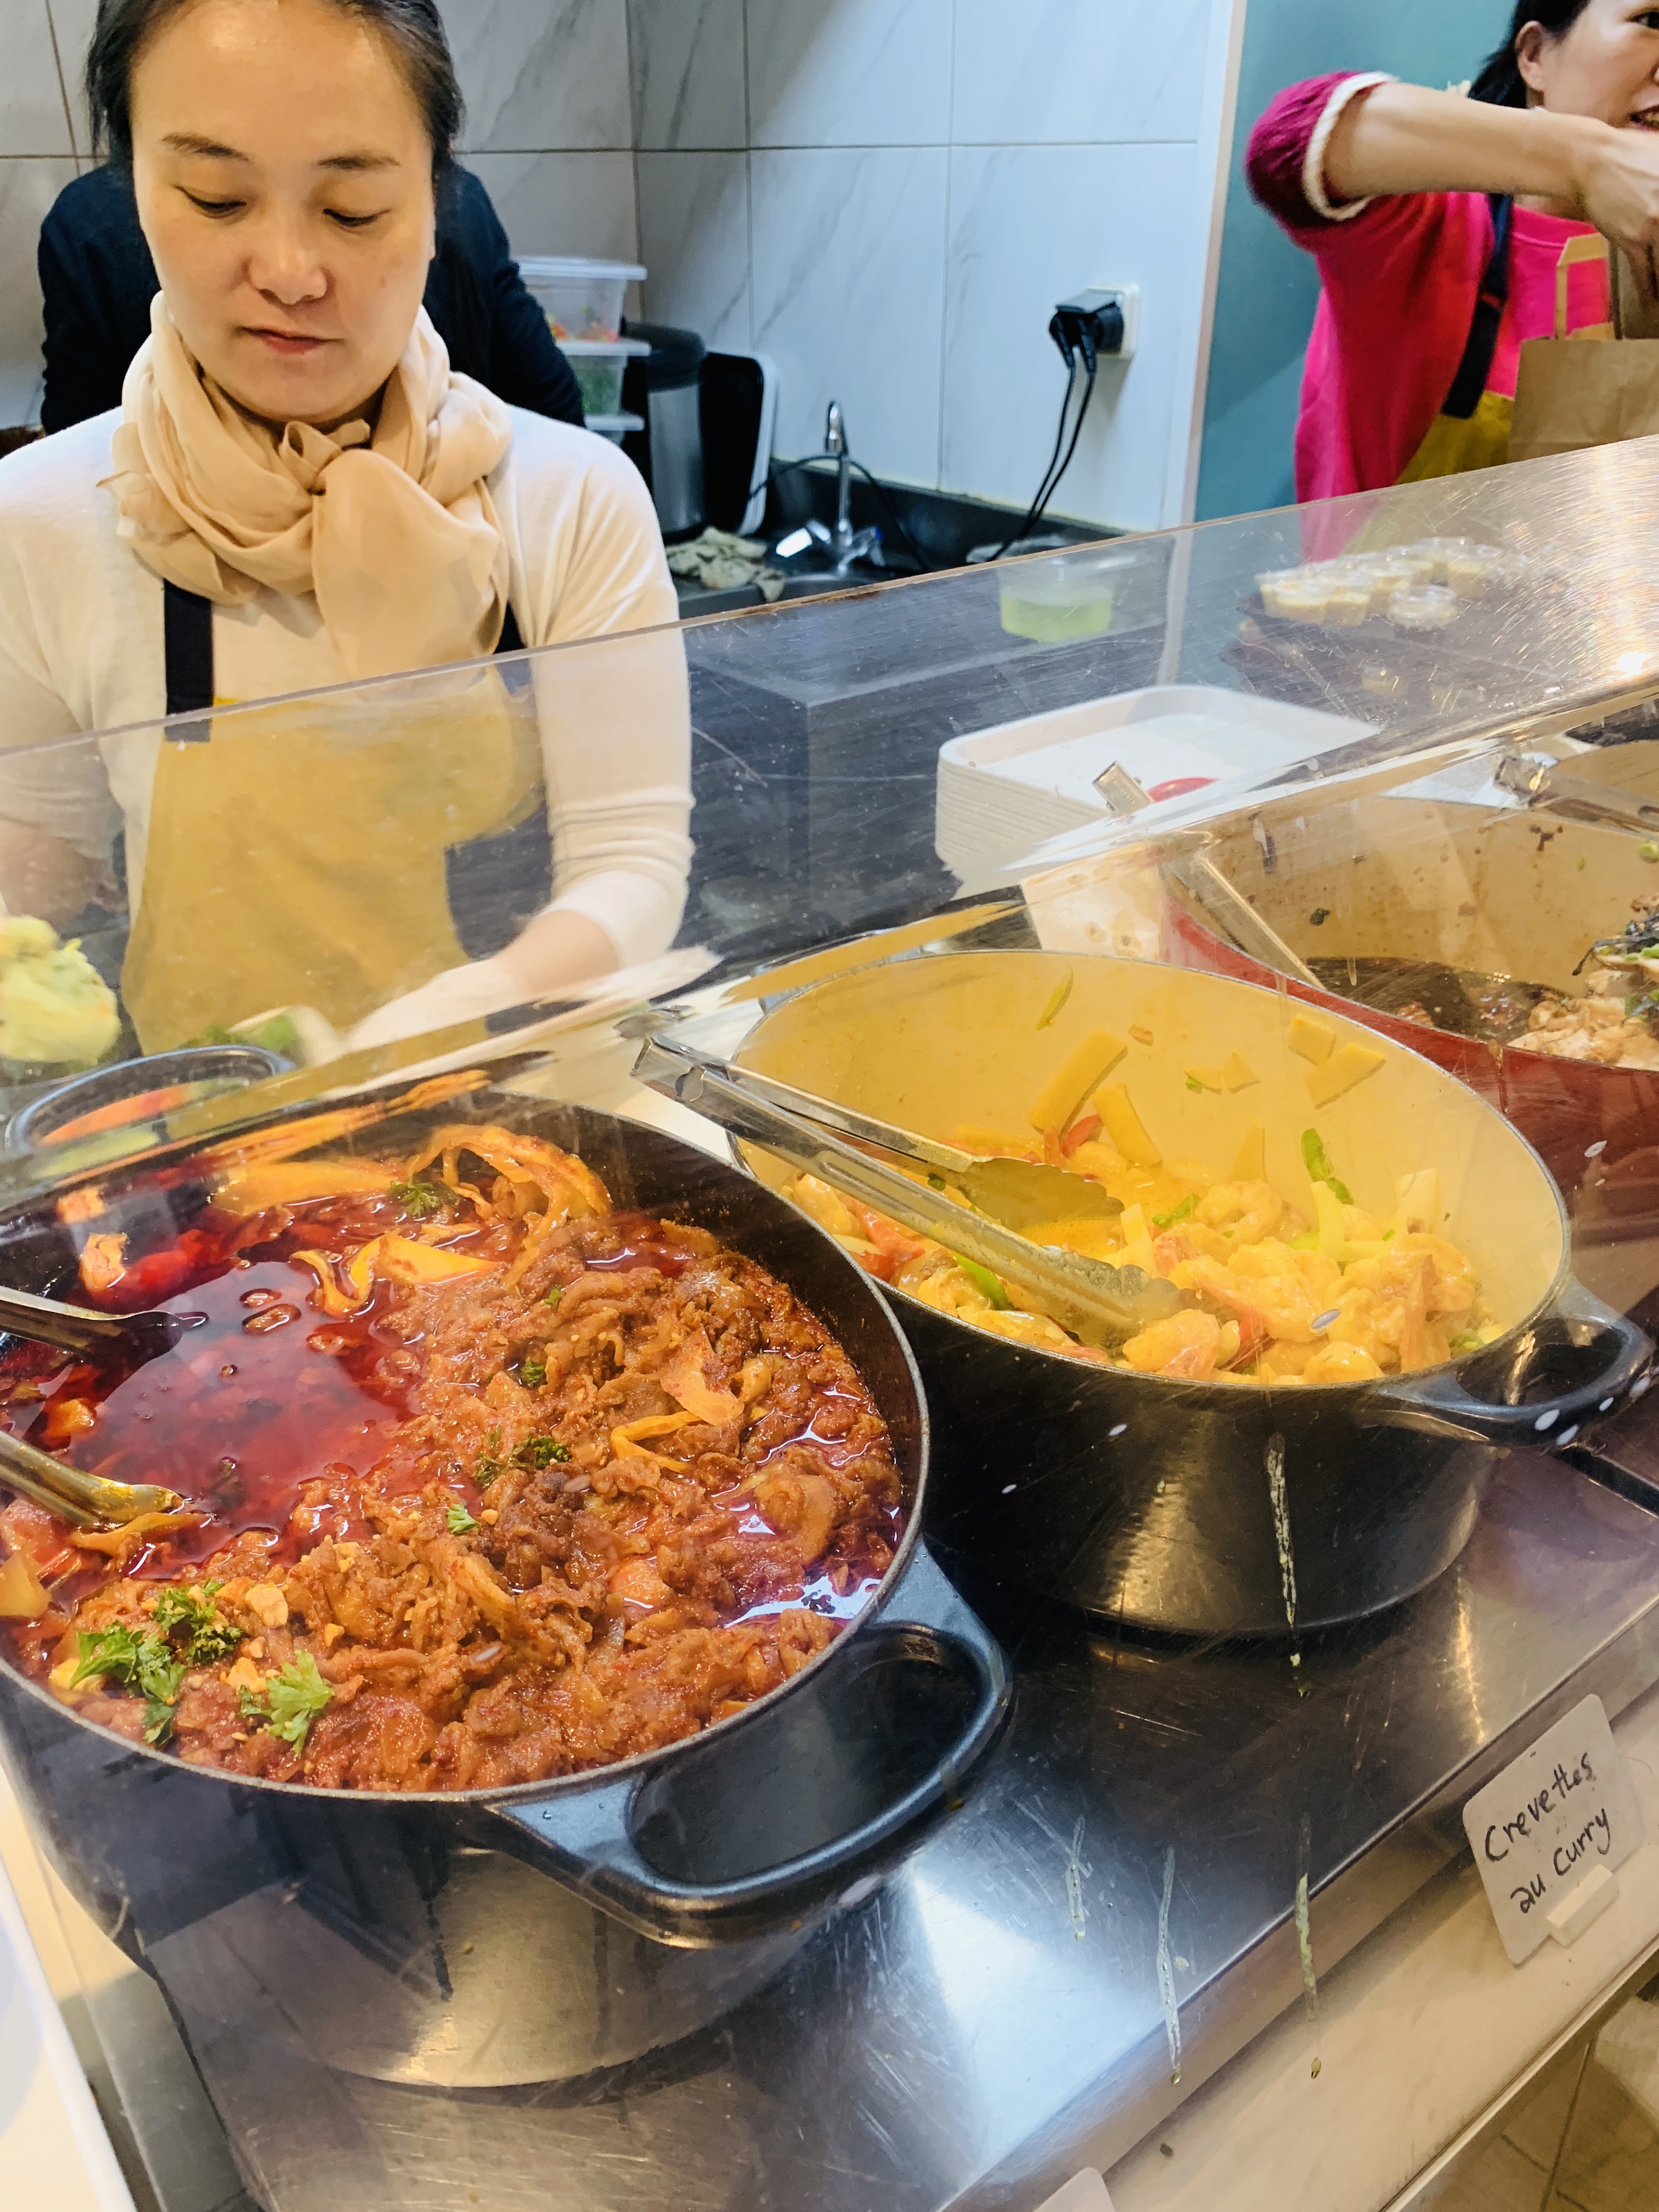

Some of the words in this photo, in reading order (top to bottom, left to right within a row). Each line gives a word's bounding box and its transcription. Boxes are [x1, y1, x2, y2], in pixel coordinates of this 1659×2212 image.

[1485, 1751, 1596, 1862] Crevettes
[1510, 1873, 1547, 1914] au
[1553, 1808, 1611, 1876] Curry
